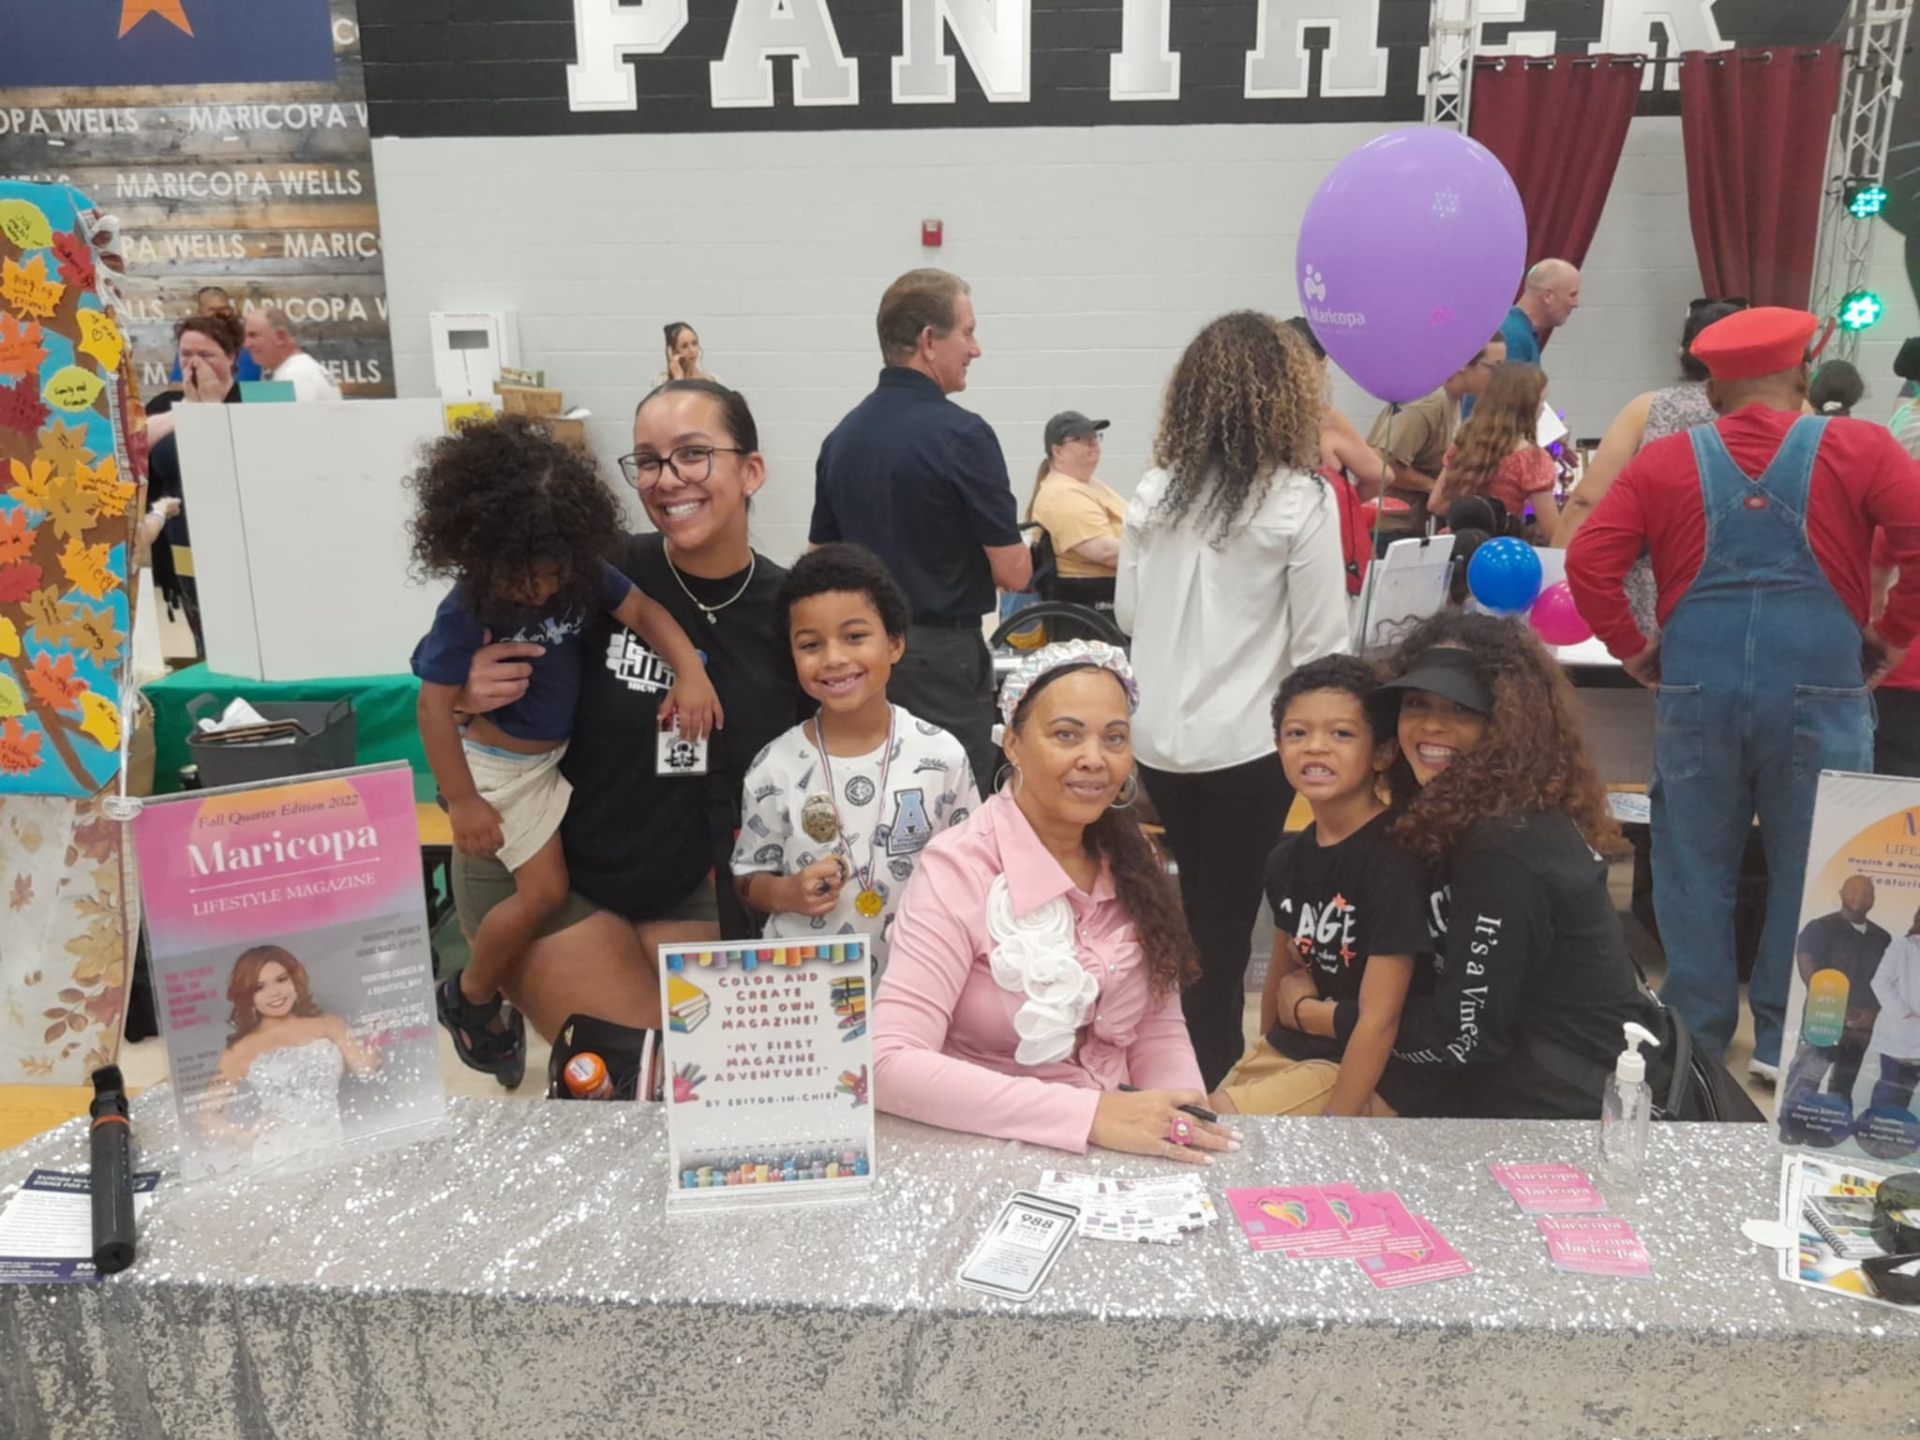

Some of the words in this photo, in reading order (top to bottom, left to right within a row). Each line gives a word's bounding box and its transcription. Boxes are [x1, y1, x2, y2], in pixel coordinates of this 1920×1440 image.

[0, 107, 49, 134] PA
[56, 107, 140, 133] WELLS
[189, 104, 347, 131] MARICOPA
[116, 171, 272, 198] MARICOPA
[278, 169, 362, 196] WELLS
[164, 234, 248, 258] WELLS
[284, 232, 382, 257] MARIC
[321, 359, 381, 383] ELLS
[199, 815, 224, 829] Fall
[229, 807, 277, 826] Quarter
[281, 800, 325, 817] Edition
[328, 794, 359, 809] 2022
[187, 825, 379, 878] Maricopa
[192, 889, 282, 917] LIFESTYLE
[286, 872, 377, 900] MAGAZINE
[1471, 914, 1502, 955] It's
[1466, 961, 1485, 976] a
[718, 974, 775, 988] COLOR
[784, 972, 819, 983] AND
[736, 987, 802, 1001] CREATE
[725, 1004, 768, 1016] YOUR
[778, 1001, 815, 1012] OWN
[721, 1015, 819, 1030] MAGAZINE!
[767, 1039, 814, 1051] FIRST
[726, 1053, 816, 1067] MAGAZINE
[705, 1099, 722, 1108] BY
[1021, 1213, 1054, 1229] 988
